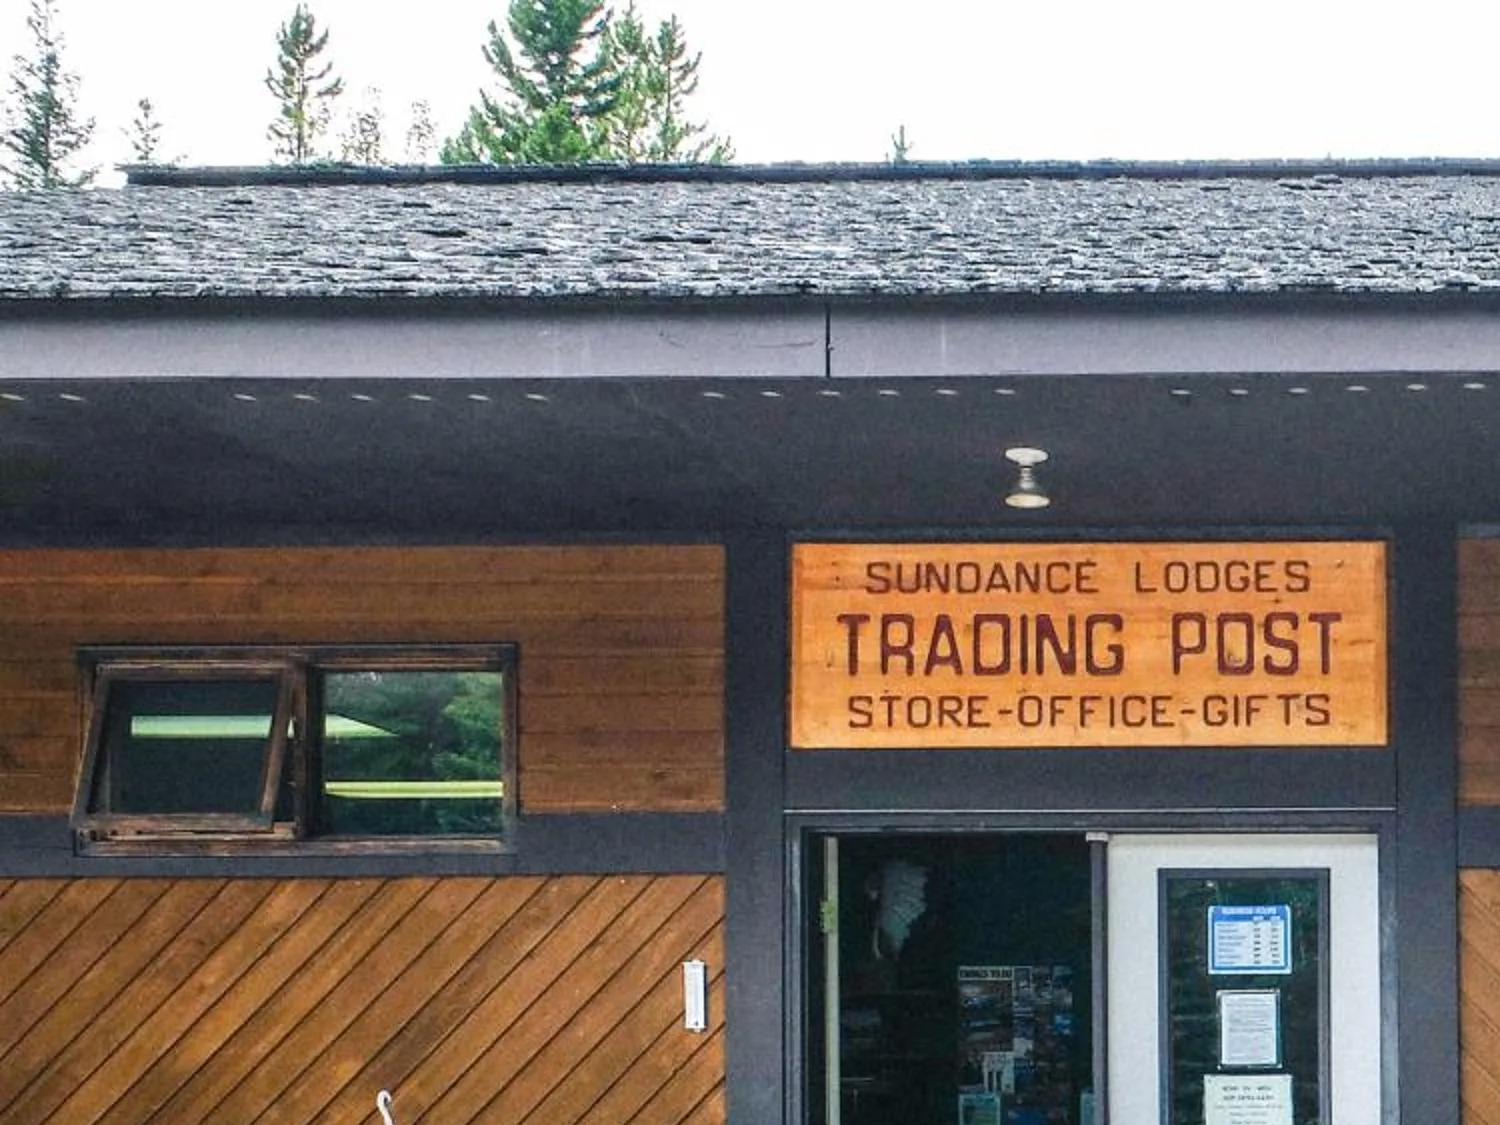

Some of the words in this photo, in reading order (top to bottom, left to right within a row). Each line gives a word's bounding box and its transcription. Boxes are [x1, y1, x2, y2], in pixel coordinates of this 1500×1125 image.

[864, 561, 1098, 595] SUNDANCE
[1134, 559, 1312, 593] LODGES
[836, 613, 1125, 677] TRADING
[1171, 611, 1343, 676] POST
[847, 694, 1332, 729] STORE-OFFICE-GIFTS
